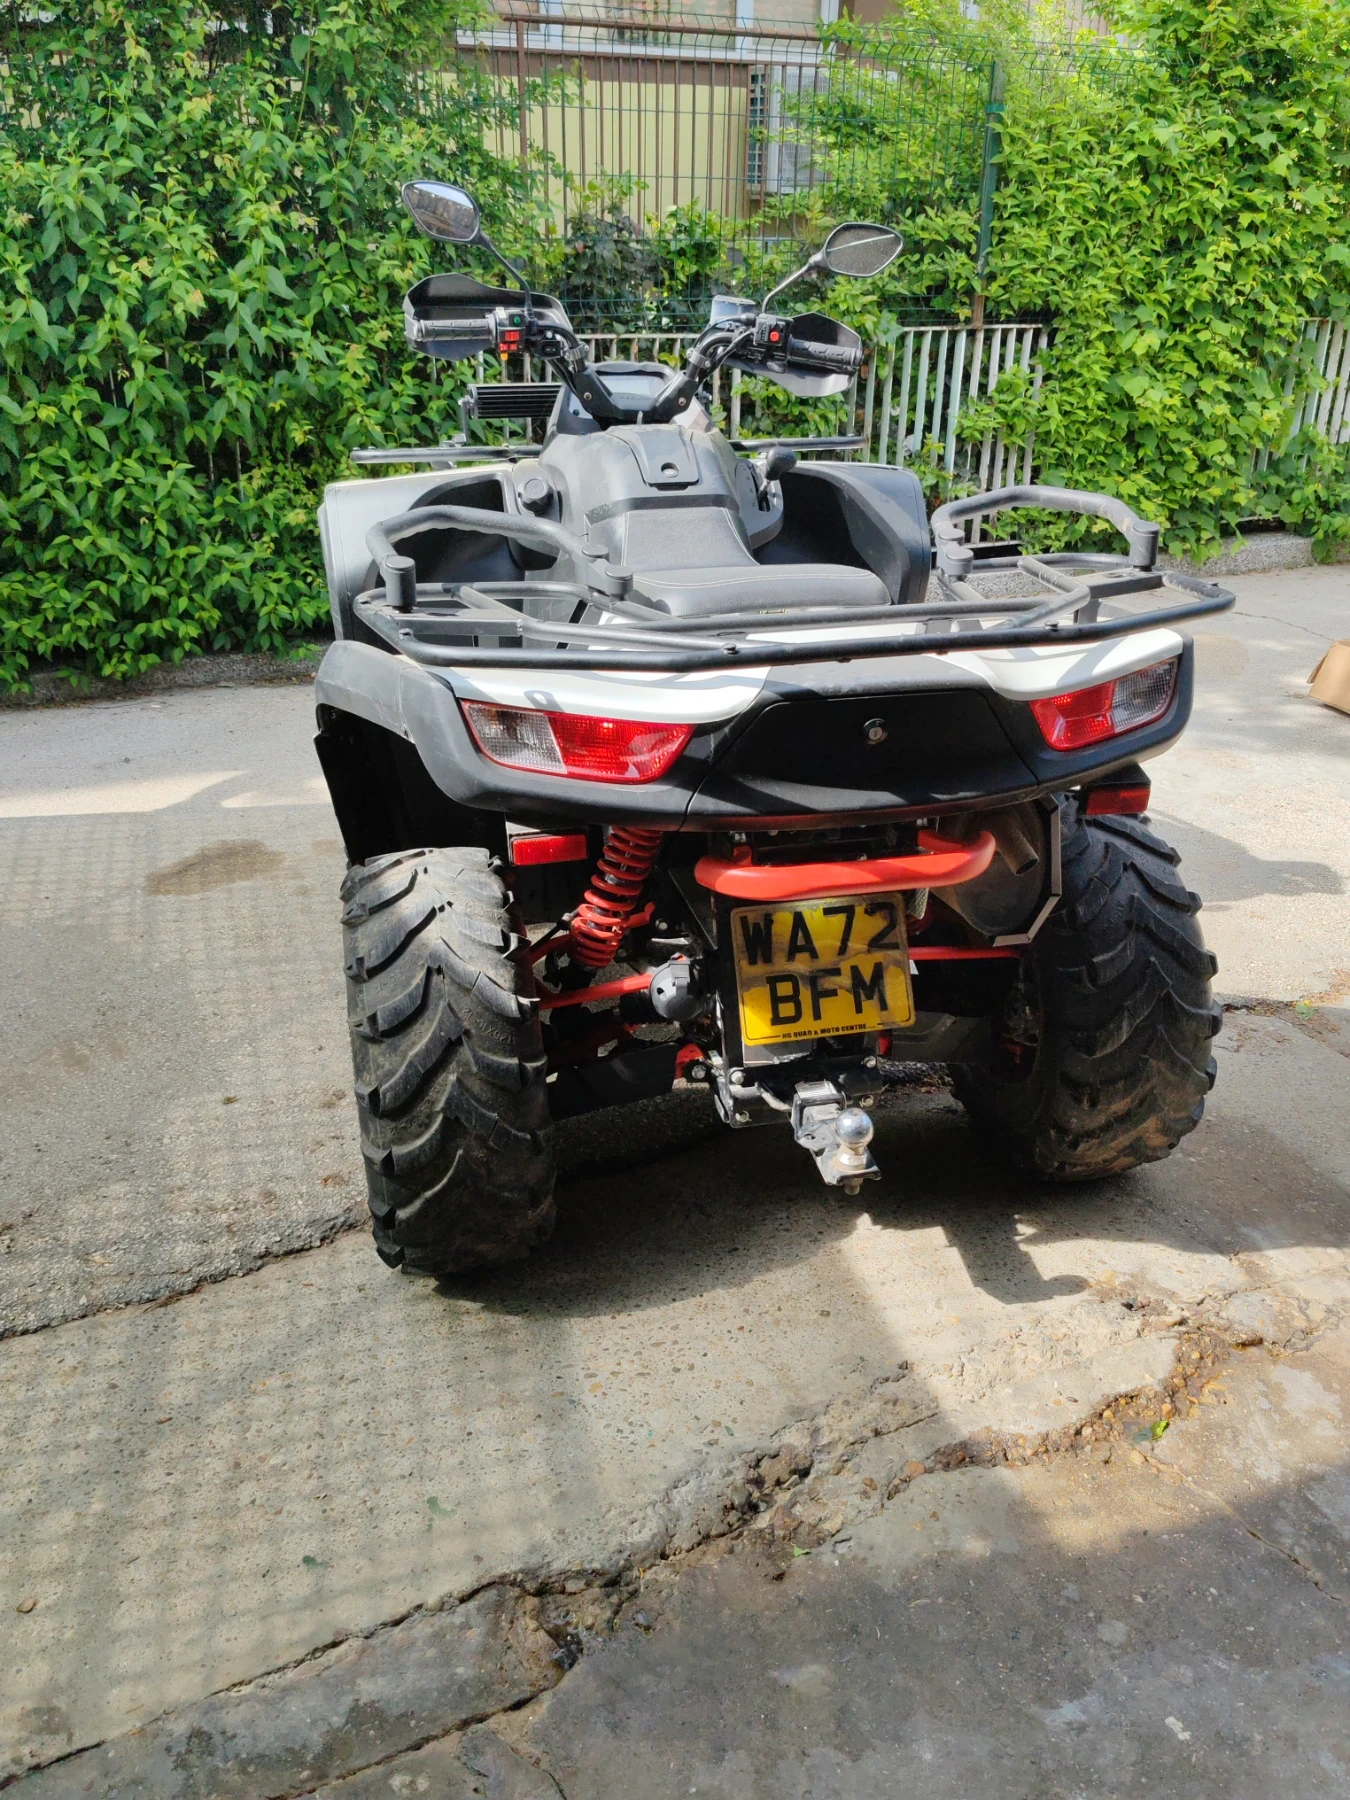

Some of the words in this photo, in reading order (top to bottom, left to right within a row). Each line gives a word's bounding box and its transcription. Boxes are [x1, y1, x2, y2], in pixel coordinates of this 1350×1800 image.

[739, 901, 900, 966] WA72
[765, 961, 889, 1026] BFM
[793, 1029, 813, 1039] QUAD
[820, 1026, 840, 1035] MOTO
[841, 1023, 867, 1032] CENTRE
